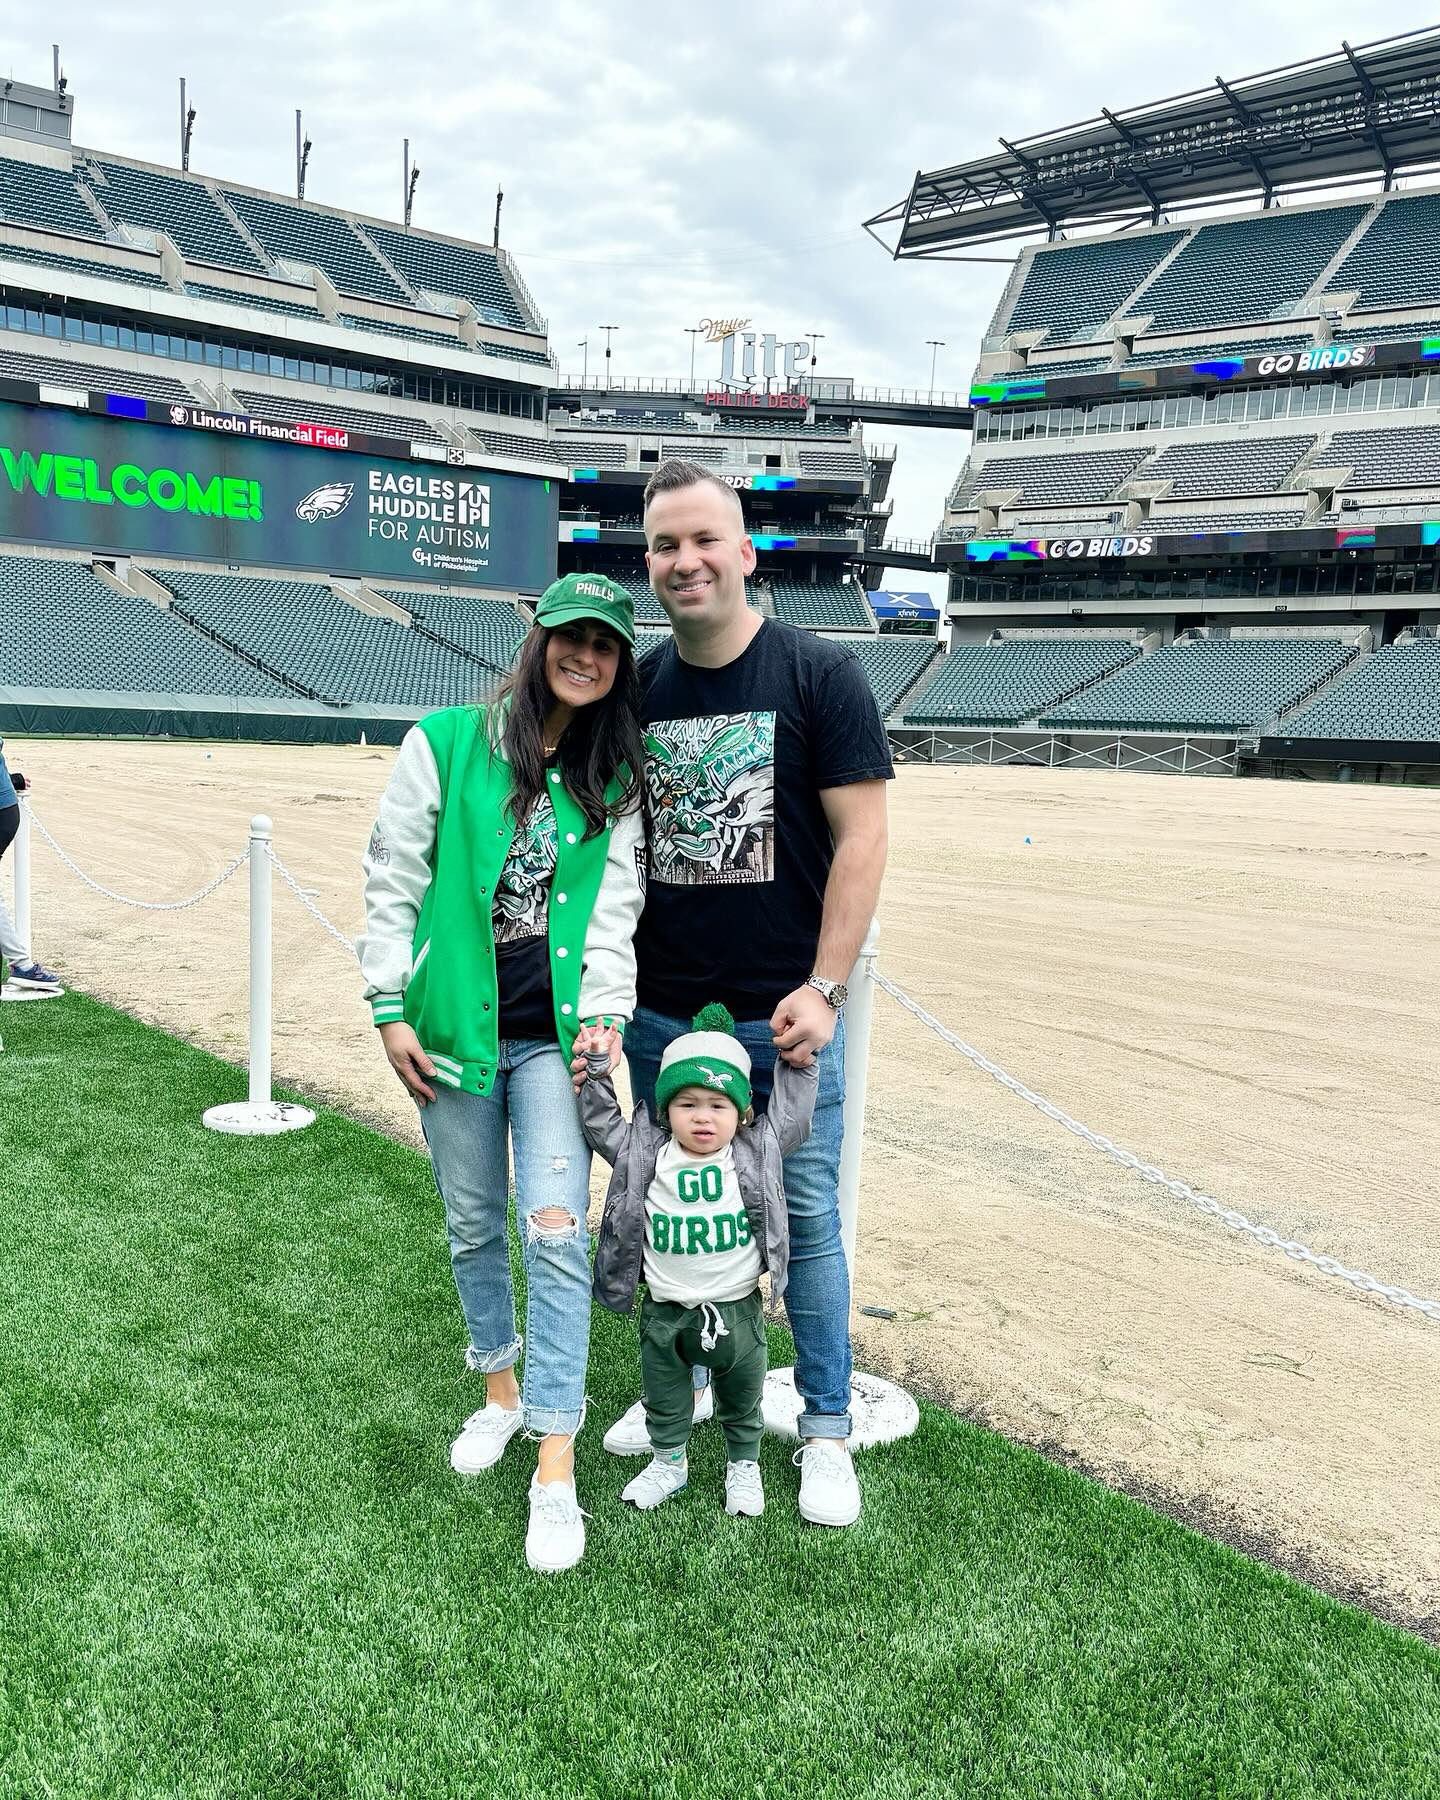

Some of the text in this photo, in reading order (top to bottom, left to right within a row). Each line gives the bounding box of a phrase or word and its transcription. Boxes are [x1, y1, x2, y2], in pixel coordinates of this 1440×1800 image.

[699, 318, 752, 340] Miller
[715, 332, 810, 392] Lite
[1258, 347, 1367, 375] GO BIRDS
[705, 392, 810, 410] PHLITE DECK
[192, 410, 349, 448] Lincoln Financial Field
[0, 447, 264, 523] WELCOME!
[368, 470, 455, 501] EAGLES
[721, 476, 752, 490] RDS
[368, 494, 455, 523] HUDDLE
[368, 518, 490, 551] FOR AUTISM
[1050, 537, 1153, 558] GO BIRDS
[433, 553, 489, 566] Children's Hospital
[441, 561, 479, 572] Philadelphia
[575, 582, 615, 603] PHILLY
[674, 714, 728, 747] JUMP
[708, 712, 774, 787] EAGLES
[677, 1164, 723, 1203] GO
[652, 1209, 753, 1255] BIRDS
